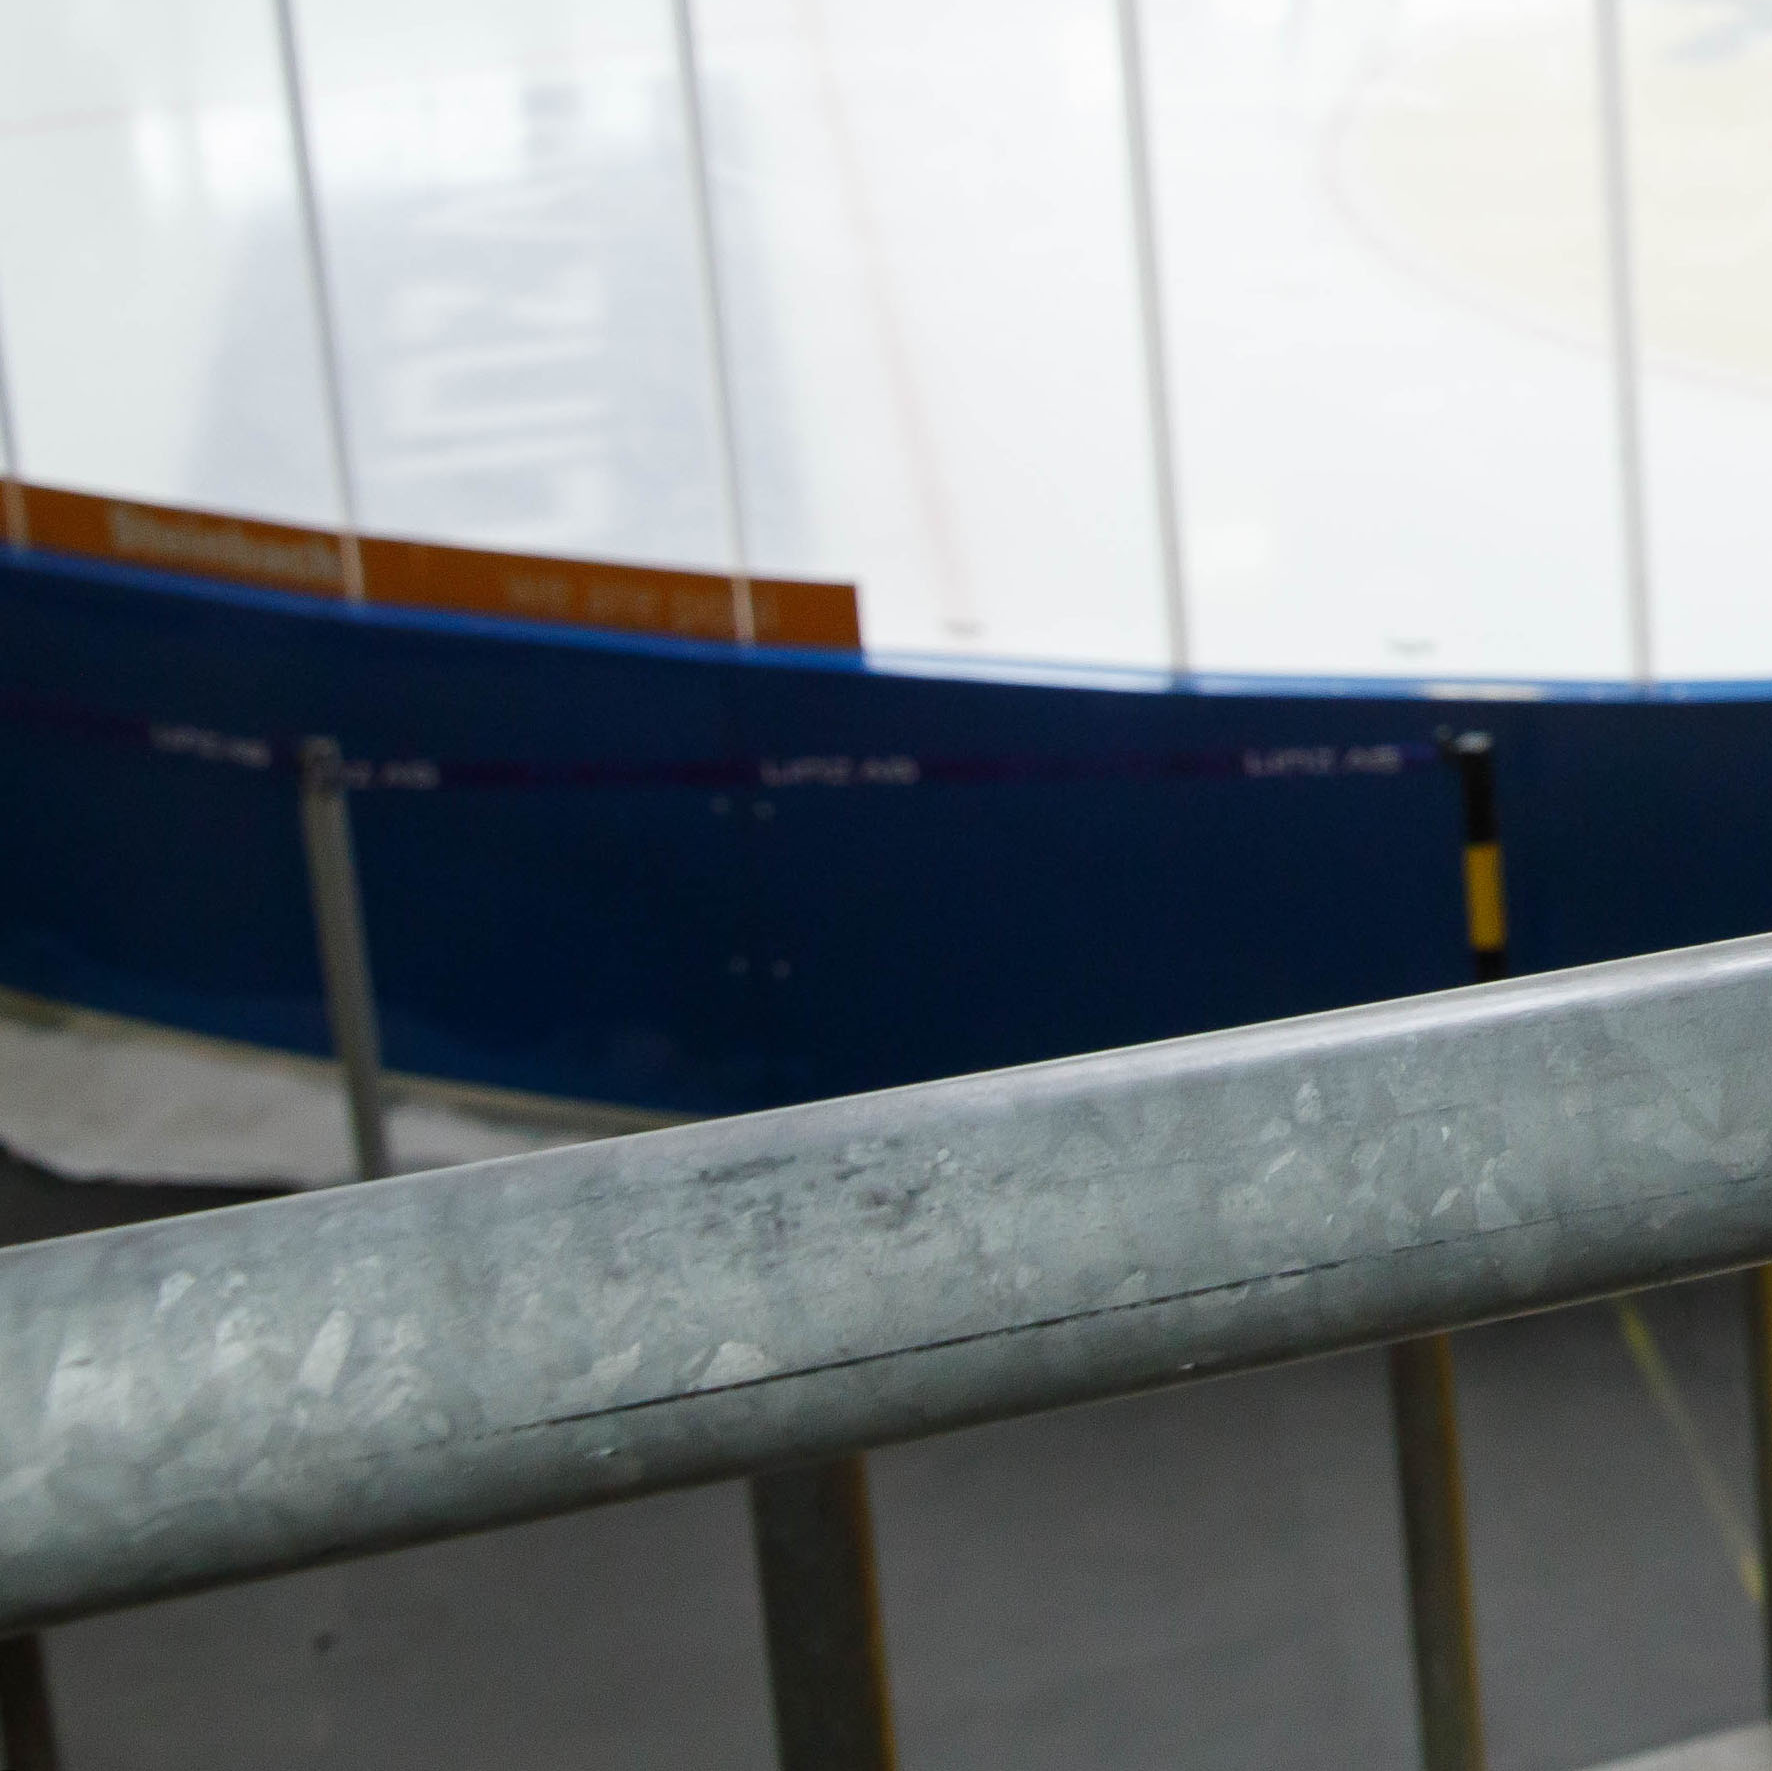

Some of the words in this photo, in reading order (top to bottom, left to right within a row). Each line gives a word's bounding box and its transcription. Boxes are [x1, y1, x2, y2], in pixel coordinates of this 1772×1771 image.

[760, 755, 852, 787] LINZ
[858, 754, 921, 785] AG
[1243, 747, 1336, 775] LINZ
[1343, 744, 1401, 773] AG
